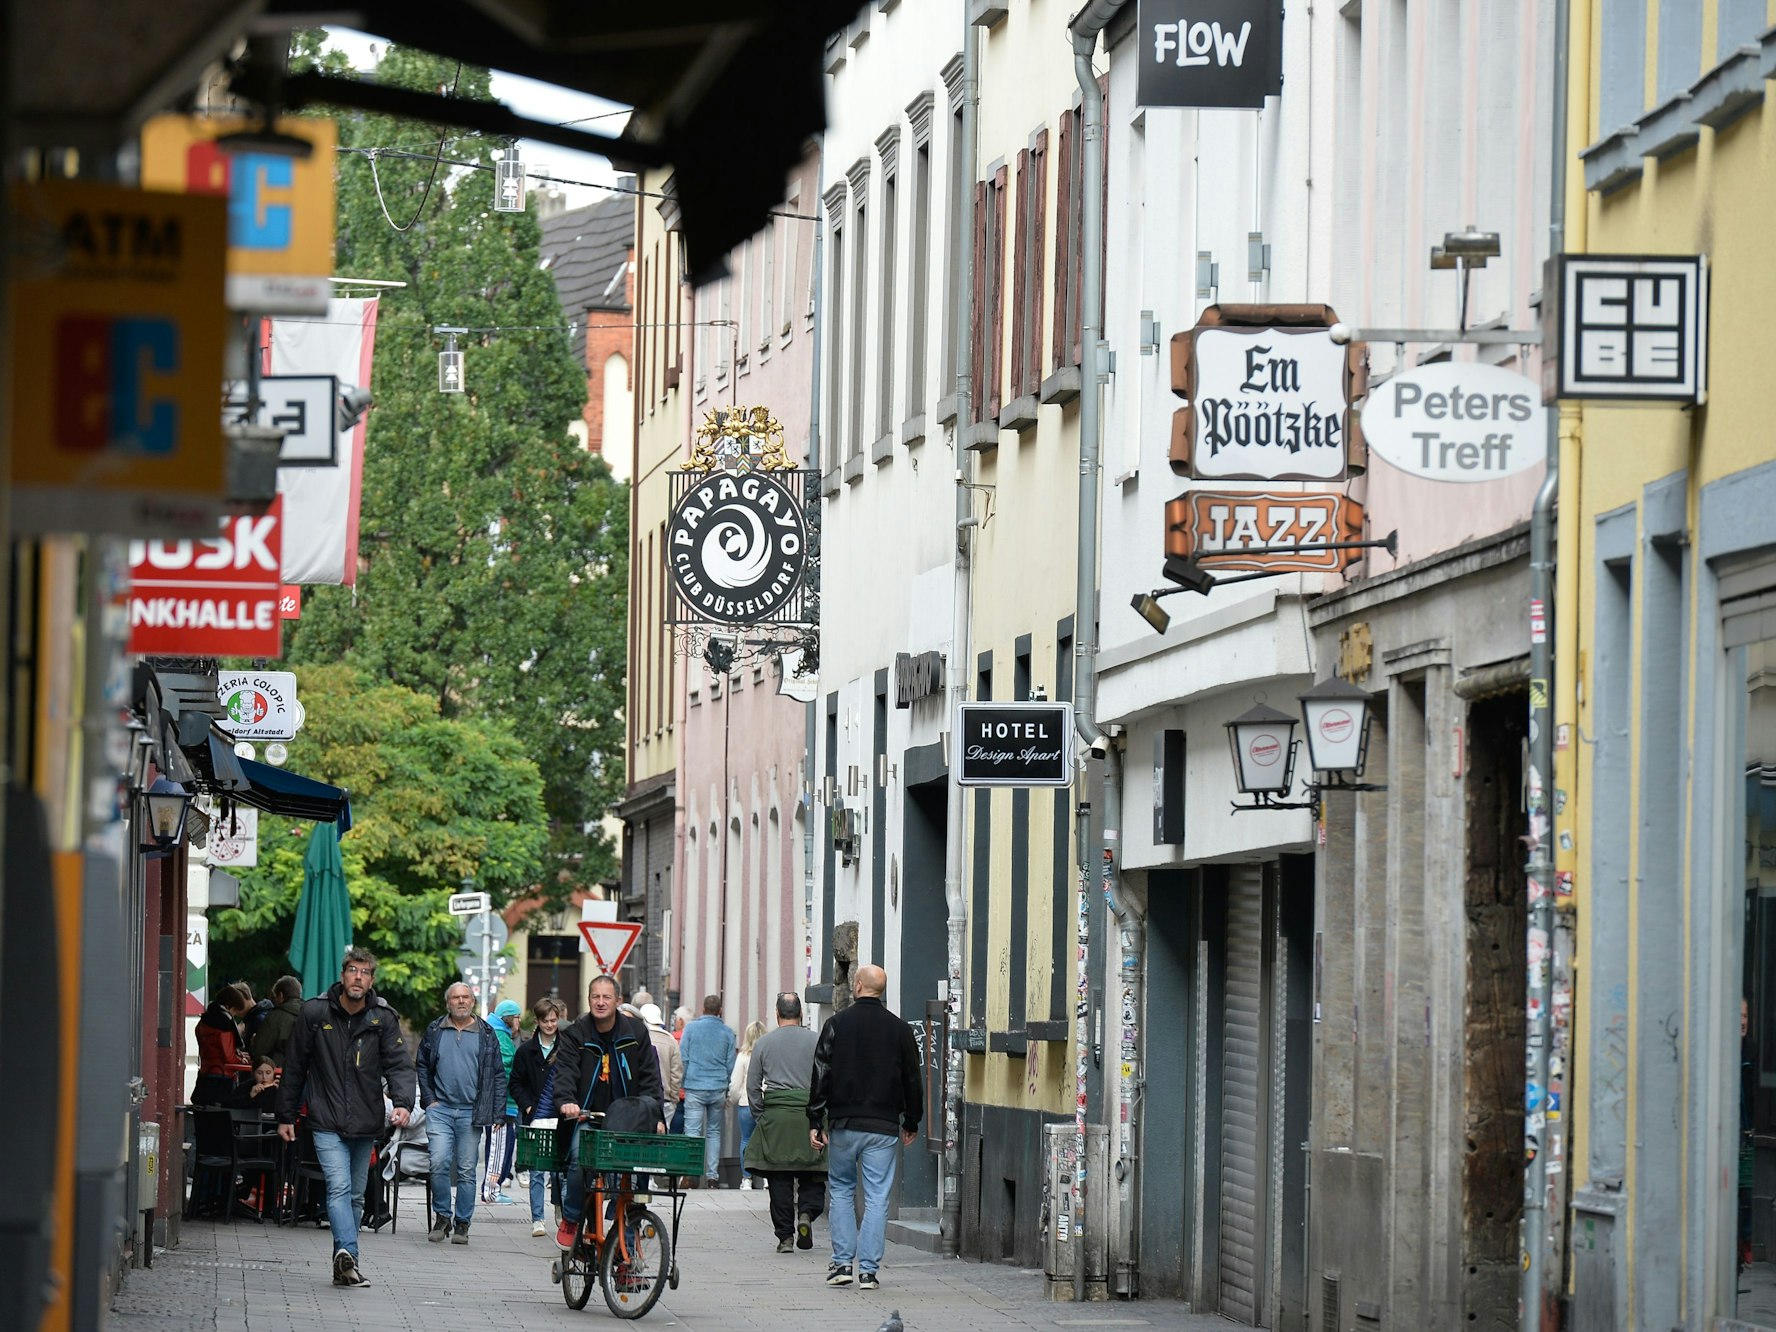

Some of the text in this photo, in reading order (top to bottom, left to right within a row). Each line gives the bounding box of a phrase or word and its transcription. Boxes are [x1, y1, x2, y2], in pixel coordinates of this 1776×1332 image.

[1154, 19, 1251, 67] FLOW
[62, 213, 182, 257] ATM
[1240, 345, 1301, 393] Em
[1394, 382, 1532, 421] Peters
[1201, 398, 1341, 458] Pöötzke
[1412, 432, 1513, 471] Treff
[674, 477, 800, 556] PAPAGAYO
[1202, 504, 1328, 556] JAZZ
[279, 595, 296, 612] te
[676, 553, 795, 617] CLUB DÜSSELDORF
[130, 597, 275, 630] NKHALLE
[217, 677, 248, 696] ZERIA
[981, 723, 1049, 738] HOTEL
[965, 744, 1061, 766] Design Apart
